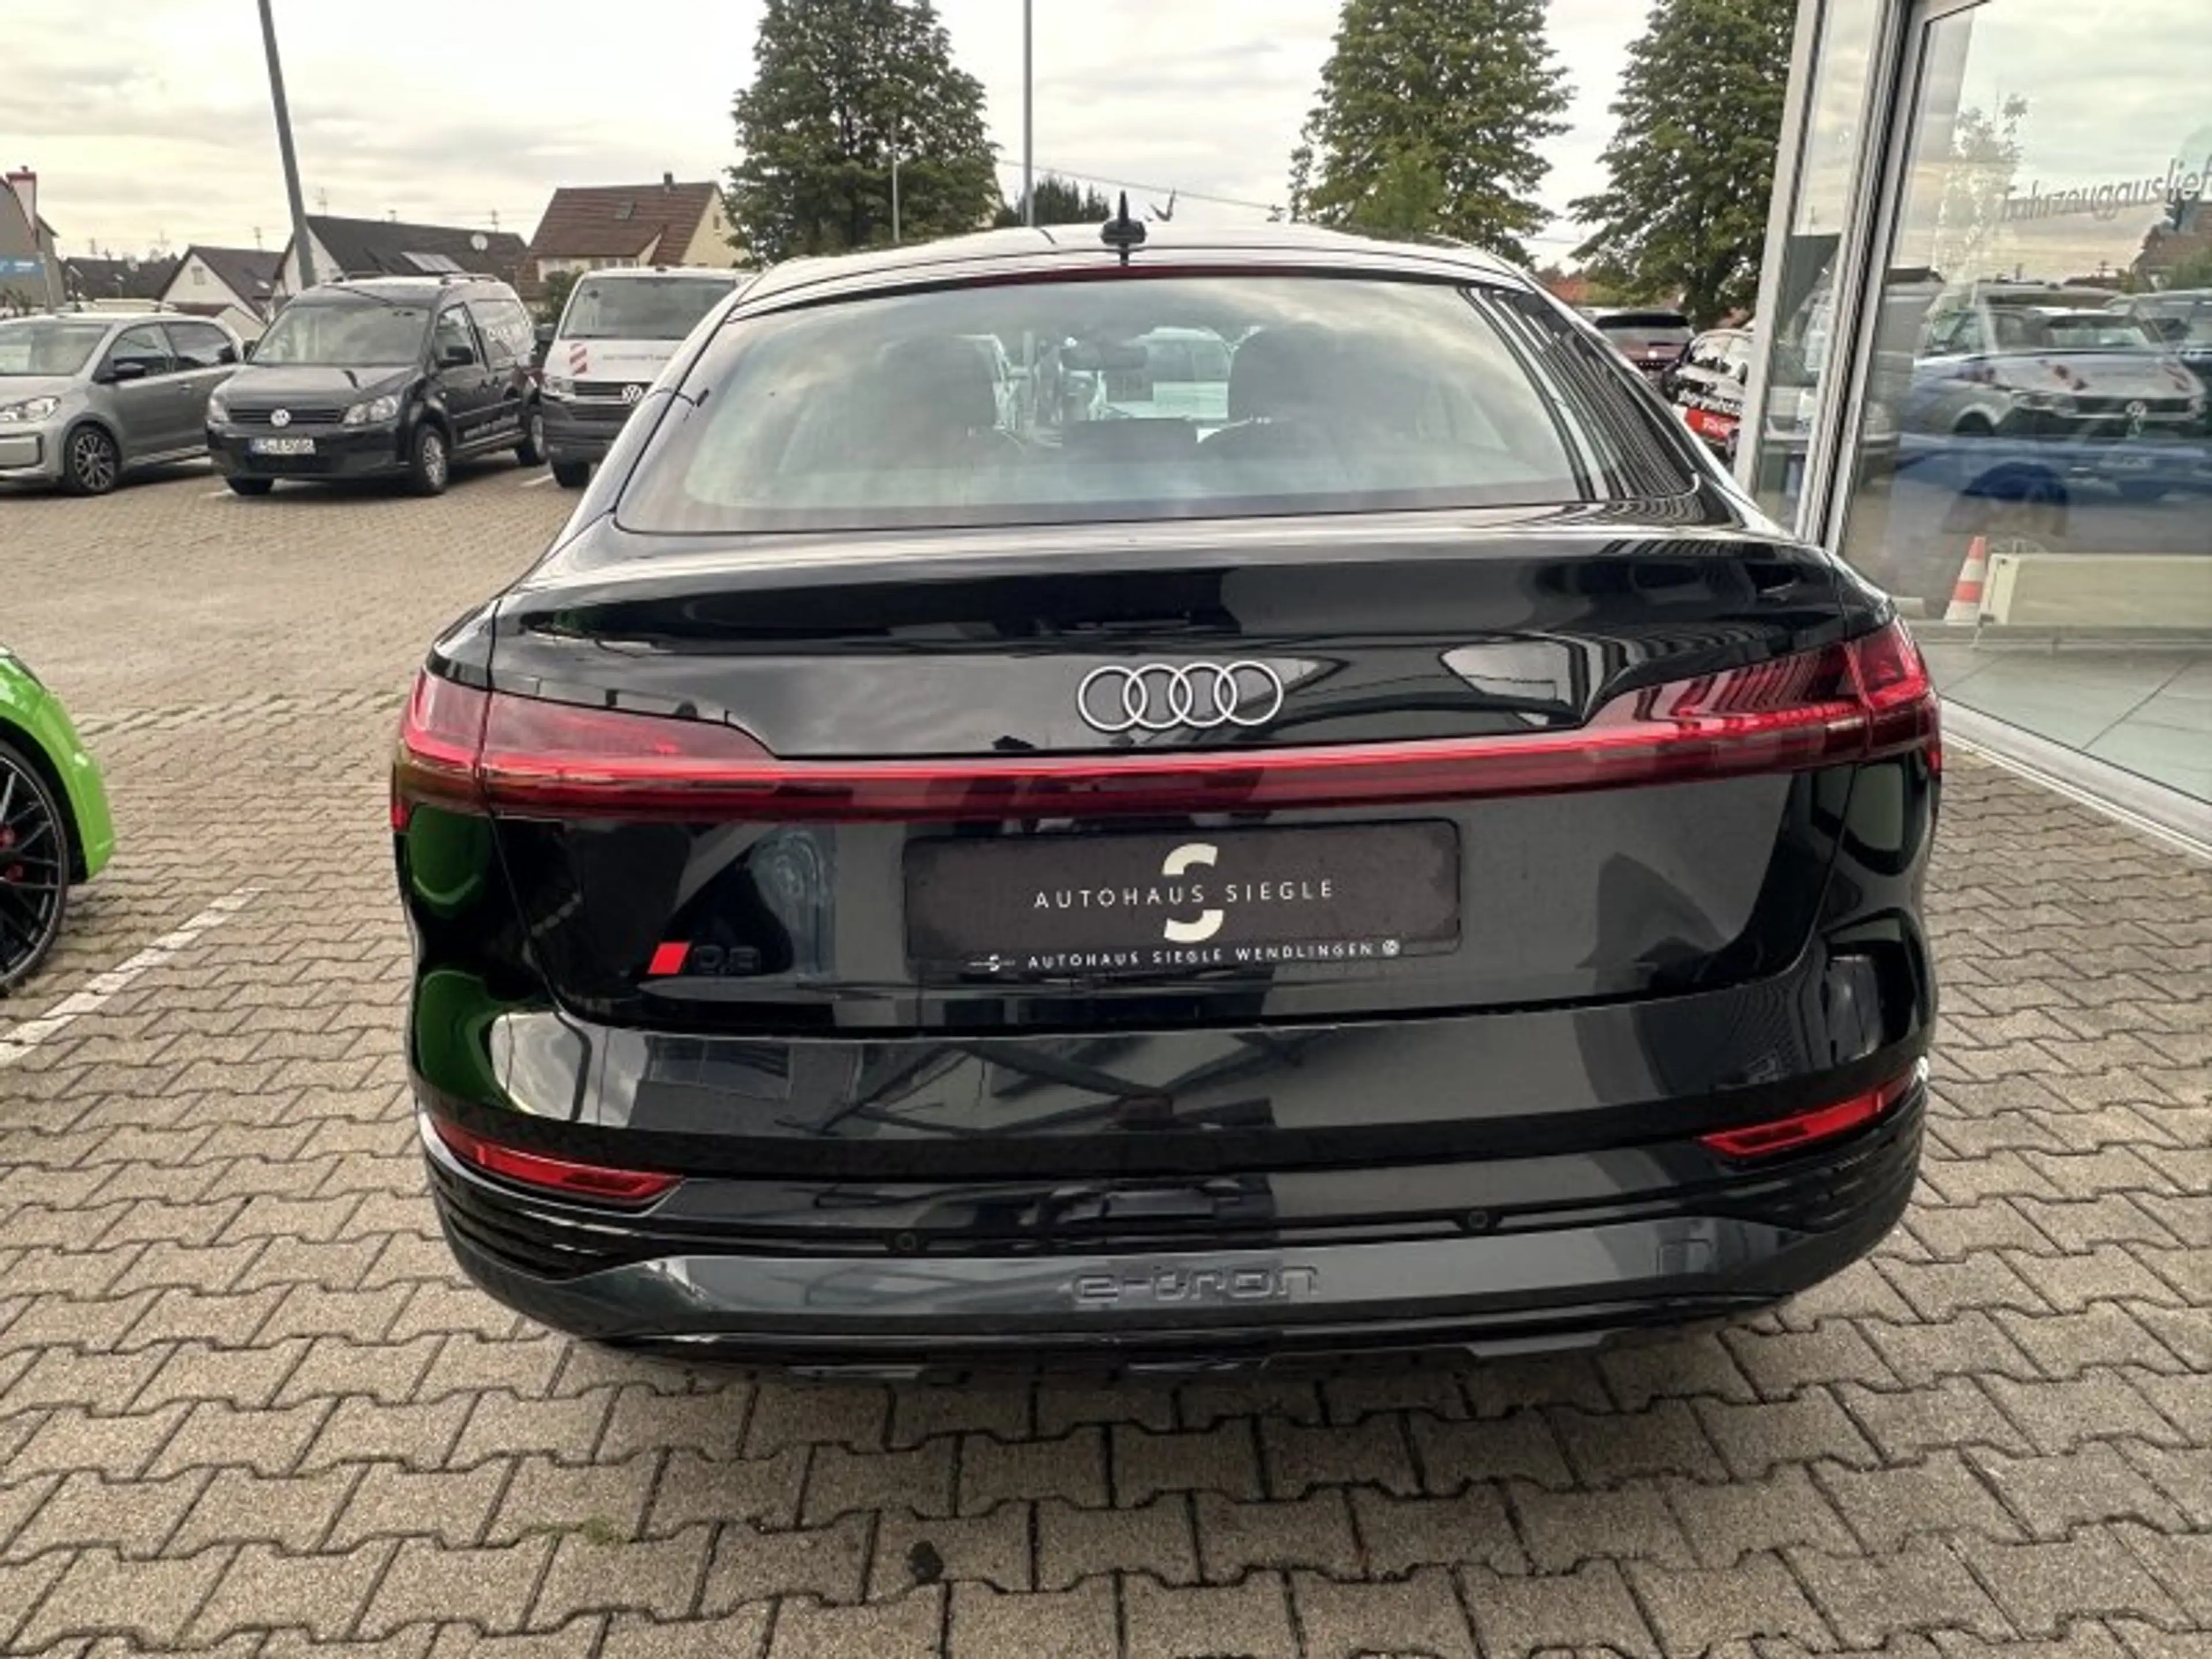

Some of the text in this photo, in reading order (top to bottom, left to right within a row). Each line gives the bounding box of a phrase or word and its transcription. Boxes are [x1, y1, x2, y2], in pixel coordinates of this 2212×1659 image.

[1033, 878, 1332, 909] AUTOHAUS SIEGLE
[1028, 950, 1140, 969] AUTOHAUS
[1152, 947, 1222, 964] SIEGLE
[1235, 941, 1374, 961] WENDLINGEN
[1073, 1264, 1320, 1304] e-tron
